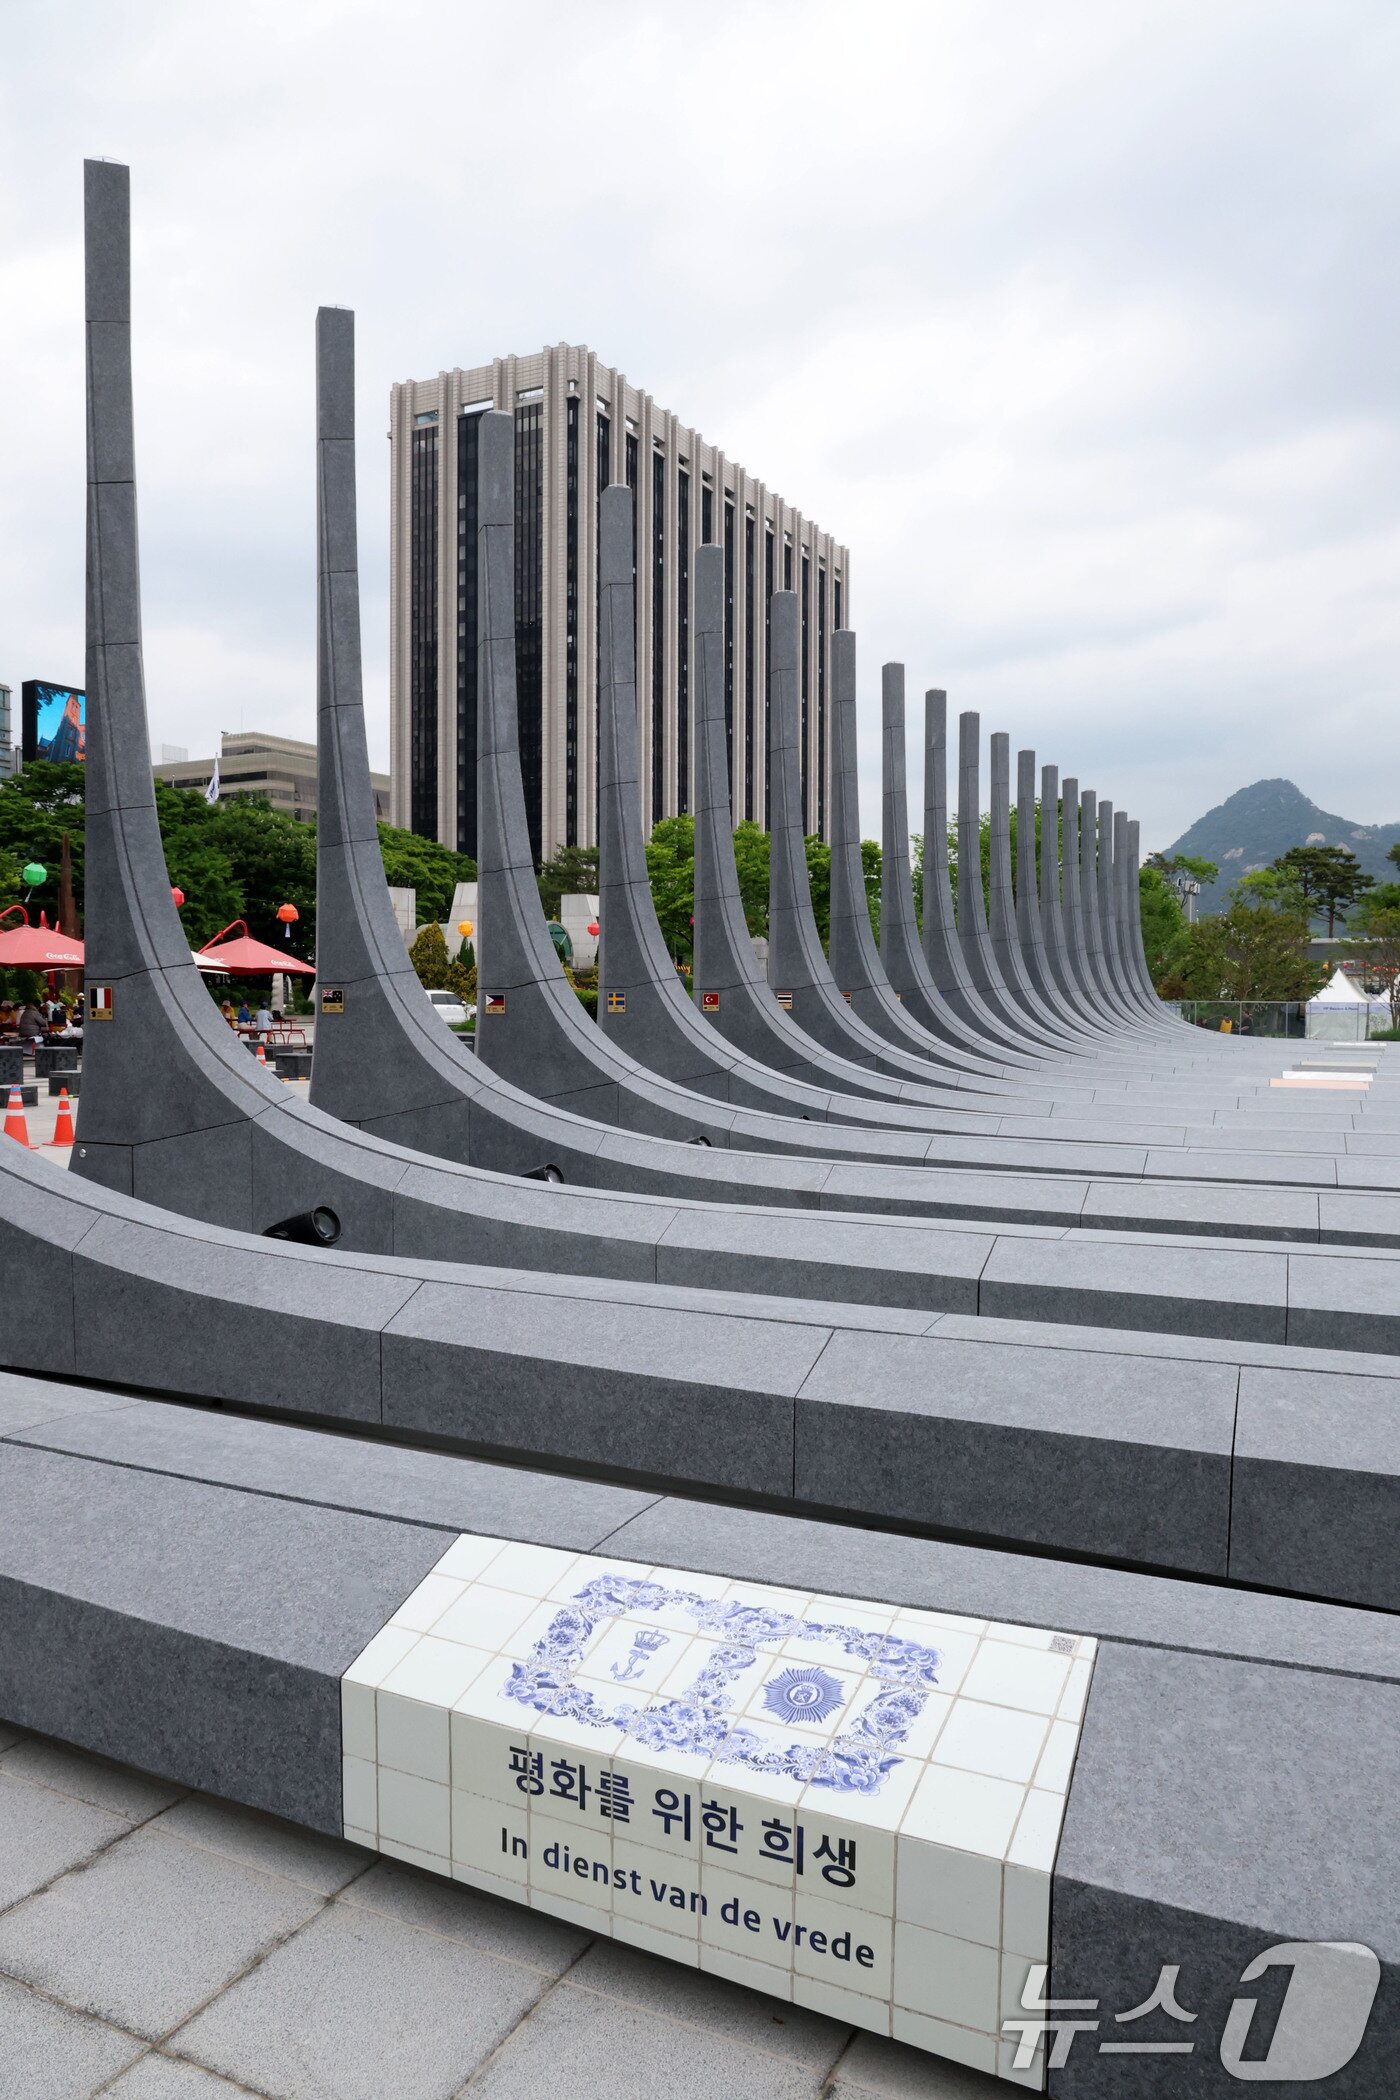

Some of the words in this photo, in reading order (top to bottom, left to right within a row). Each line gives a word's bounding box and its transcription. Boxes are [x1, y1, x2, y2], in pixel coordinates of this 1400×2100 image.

[508, 1745, 634, 1824] 평화를
[652, 1788, 743, 1854] 위한
[759, 1818, 857, 1888] 희생
[501, 1827, 527, 1860] In
[543, 1843, 642, 1896] dienst
[650, 1879, 708, 1917] van
[720, 1898, 761, 1933] de
[773, 1917, 875, 1969] vrede
